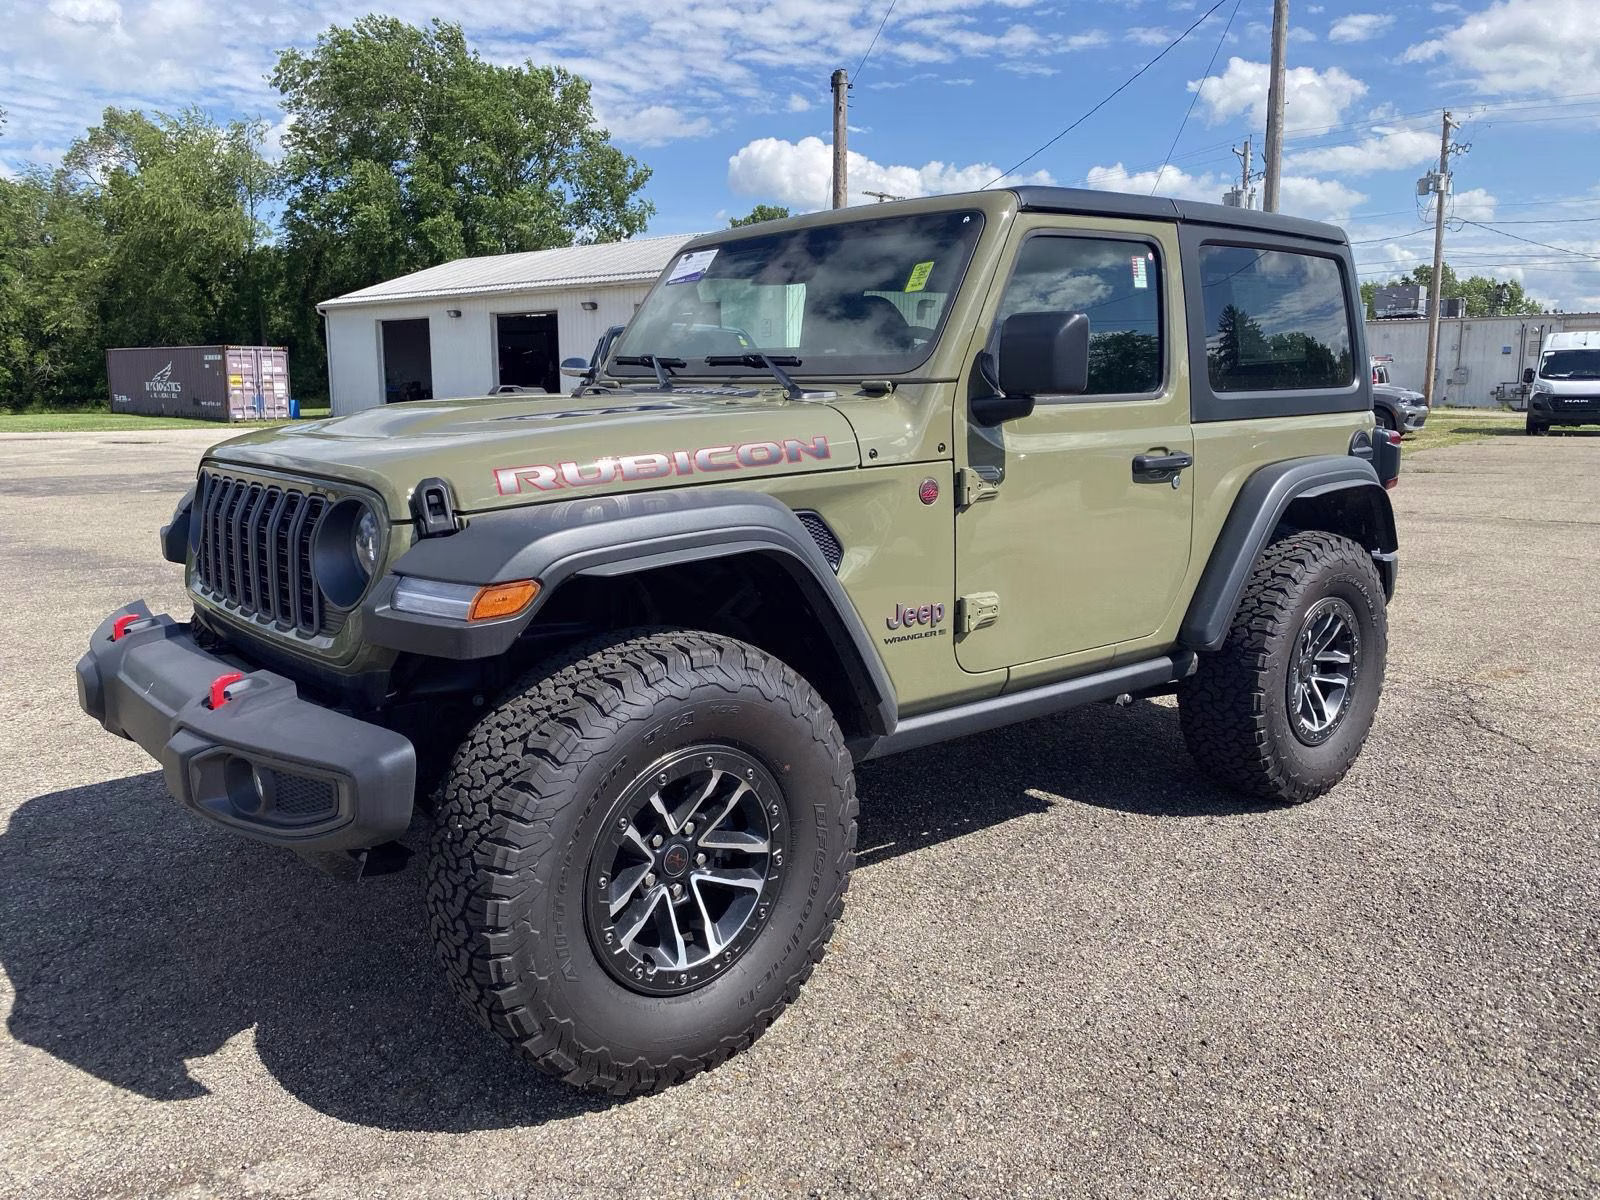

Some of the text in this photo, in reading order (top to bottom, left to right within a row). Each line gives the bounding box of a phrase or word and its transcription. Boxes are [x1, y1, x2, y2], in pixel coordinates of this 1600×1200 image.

[494, 436, 831, 496] RUBICON
[886, 602, 945, 630] Jeep
[883, 630, 937, 645] WRANGLER
[642, 710, 697, 747] T/A
[737, 802, 829, 1010] BFGoodrich
